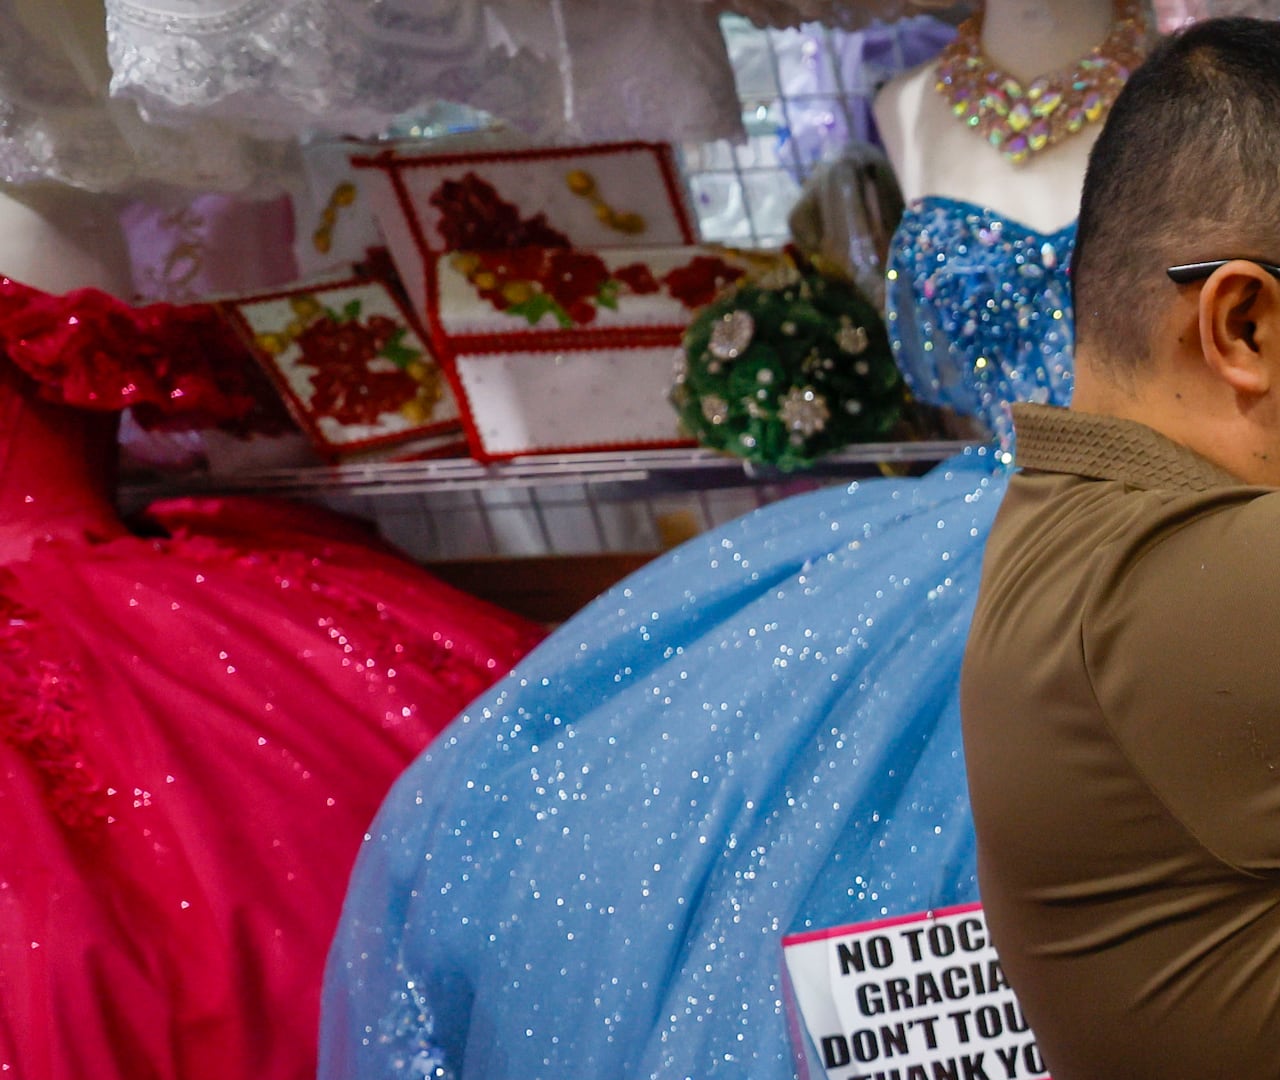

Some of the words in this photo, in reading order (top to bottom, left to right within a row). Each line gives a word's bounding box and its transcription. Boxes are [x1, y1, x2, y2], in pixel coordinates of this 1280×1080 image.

[836, 934, 894, 976] NO
[901, 917, 994, 963] TOC
[820, 1015, 939, 1070] DON'T
